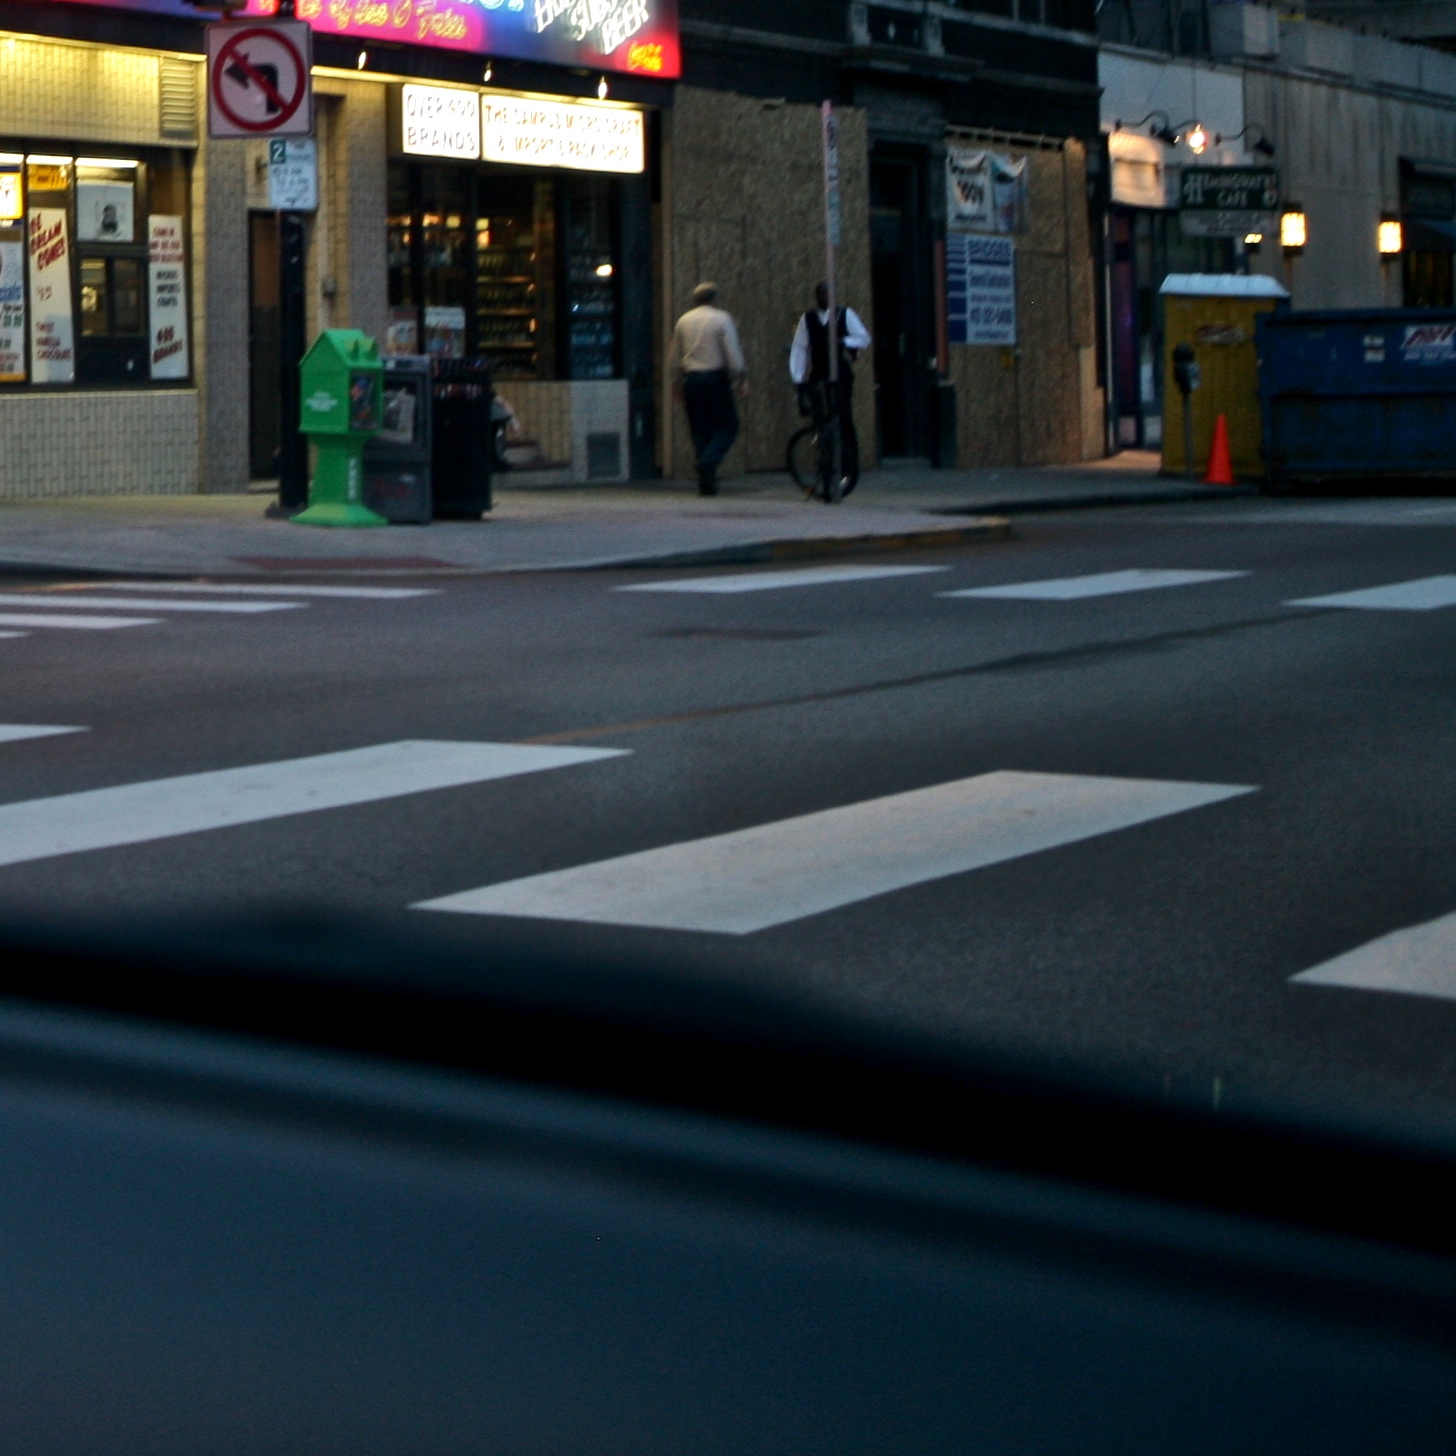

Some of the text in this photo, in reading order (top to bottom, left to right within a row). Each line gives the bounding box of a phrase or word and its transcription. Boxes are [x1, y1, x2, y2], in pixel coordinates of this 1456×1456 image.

[406, 93, 443, 119] OVER
[485, 104, 507, 124] THE
[407, 126, 476, 152] BRANDS
[272, 142, 284, 162] 2
